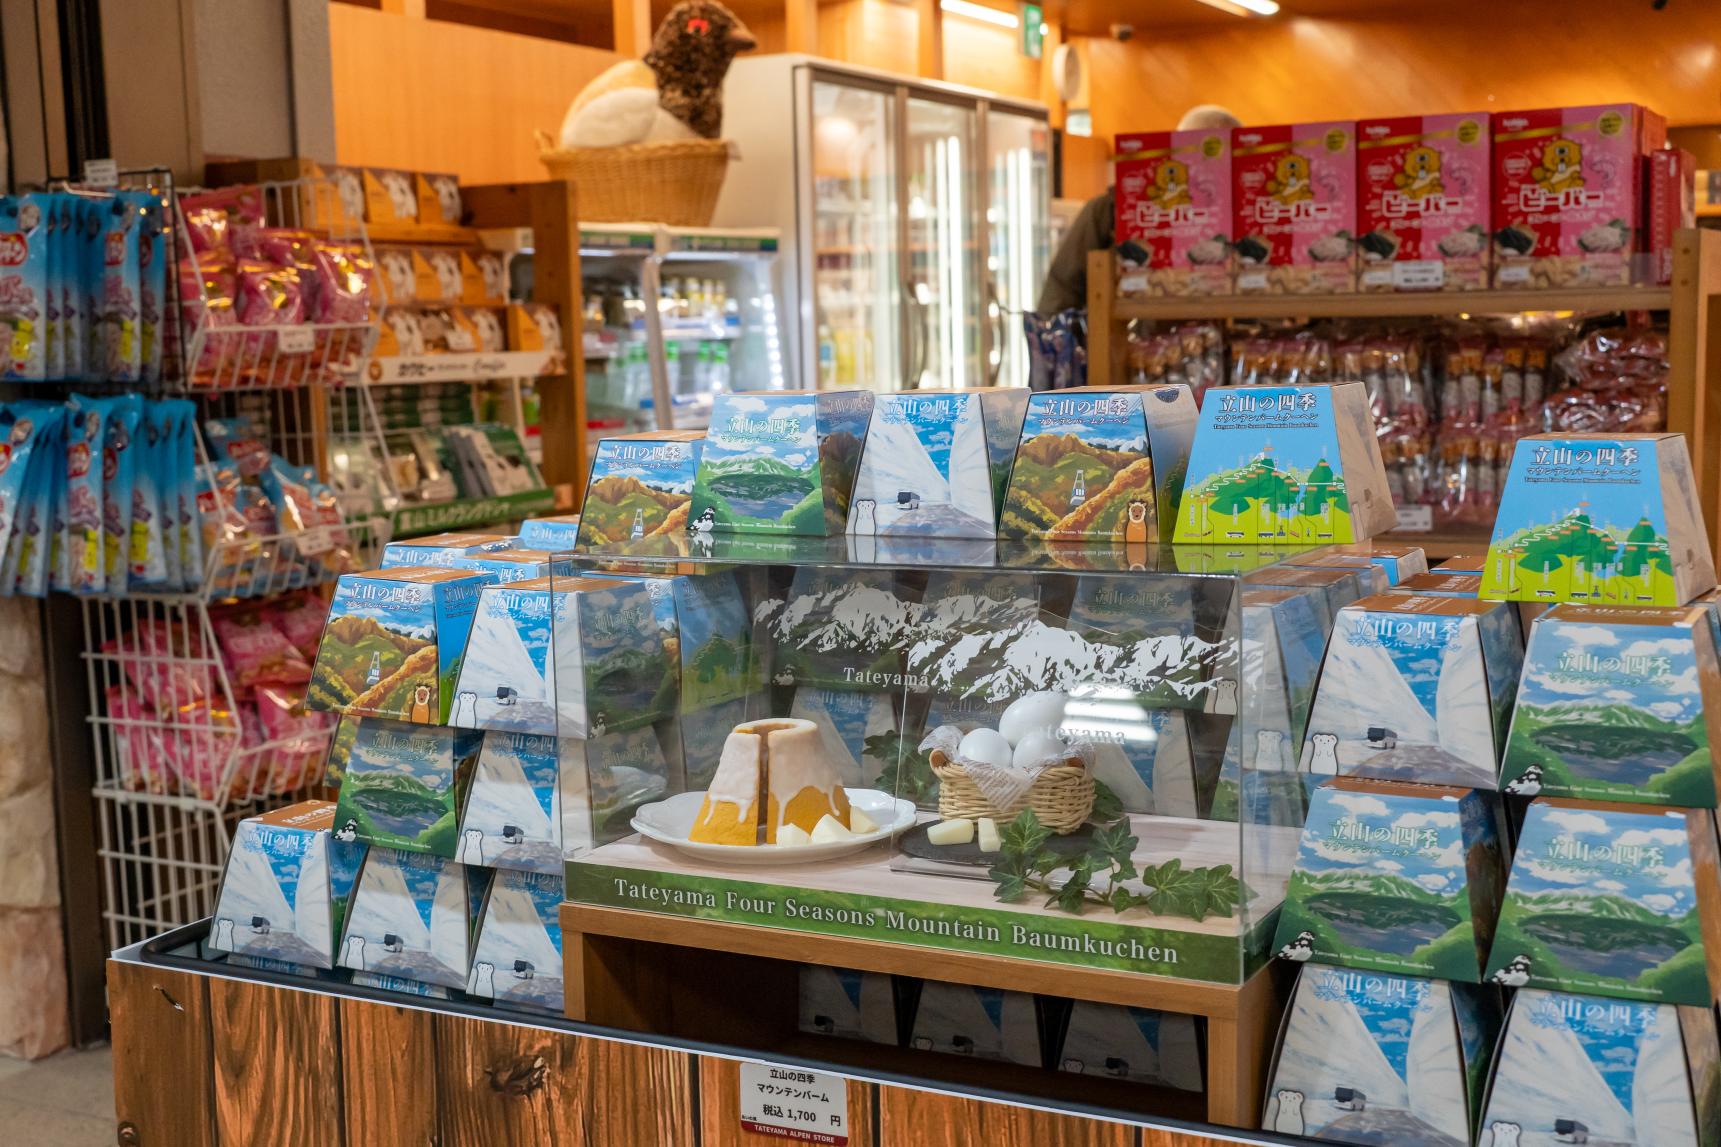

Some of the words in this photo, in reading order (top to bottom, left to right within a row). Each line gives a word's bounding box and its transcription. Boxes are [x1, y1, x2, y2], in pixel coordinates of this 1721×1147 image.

[1382, 190, 1463, 217] ビーバー
[1519, 184, 1604, 212] ビーバー
[1135, 201, 1209, 228] ビーバー
[1256, 196, 1331, 224] ビーバー
[887, 398, 969, 416] 立山の四季
[1041, 398, 1128, 417] 立山の四季
[1219, 393, 1316, 413] 立山の四季
[728, 416, 800, 435] 立山の四季
[1039, 416, 1130, 425] マウンテンバームクーヘン
[1215, 412, 1319, 423] マウンテンバームクーヘン
[608, 444, 681, 461] 立山の四季
[1530, 446, 1639, 466] 立山の四季
[1527, 466, 1641, 477] マウンテンバームクーヘン
[351, 582, 422, 604] 立山の四季
[494, 592, 564, 612] 立山の四季
[1355, 615, 1459, 641] 立山の四季
[1558, 651, 1671, 677] 立山の四季
[843, 666, 929, 688] Tateyama
[1327, 819, 1438, 848] 立山の四季
[1544, 838, 1664, 868] 立山の四季
[614, 877, 716, 907] Tateyama
[726, 891, 776, 914] Four
[786, 898, 875, 927] Seasons
[885, 910, 1001, 942] Mountain
[1012, 925, 1178, 964] Baumkuchen
[1322, 969, 1431, 1001] 立山の四季
[1535, 995, 1657, 1029] 立山の四季
[769, 1067, 815, 1085] 立山の四季
[756, 1083, 830, 1103] マウンテンバーム
[762, 1103, 784, 1118] 税込
[787, 1109, 817, 1122] 1,700
[830, 1114, 841, 1127] 円
[754, 1124, 788, 1136] TATEYAMA
[789, 1128, 811, 1139] ALPEN
[813, 1134, 835, 1144] STORE
